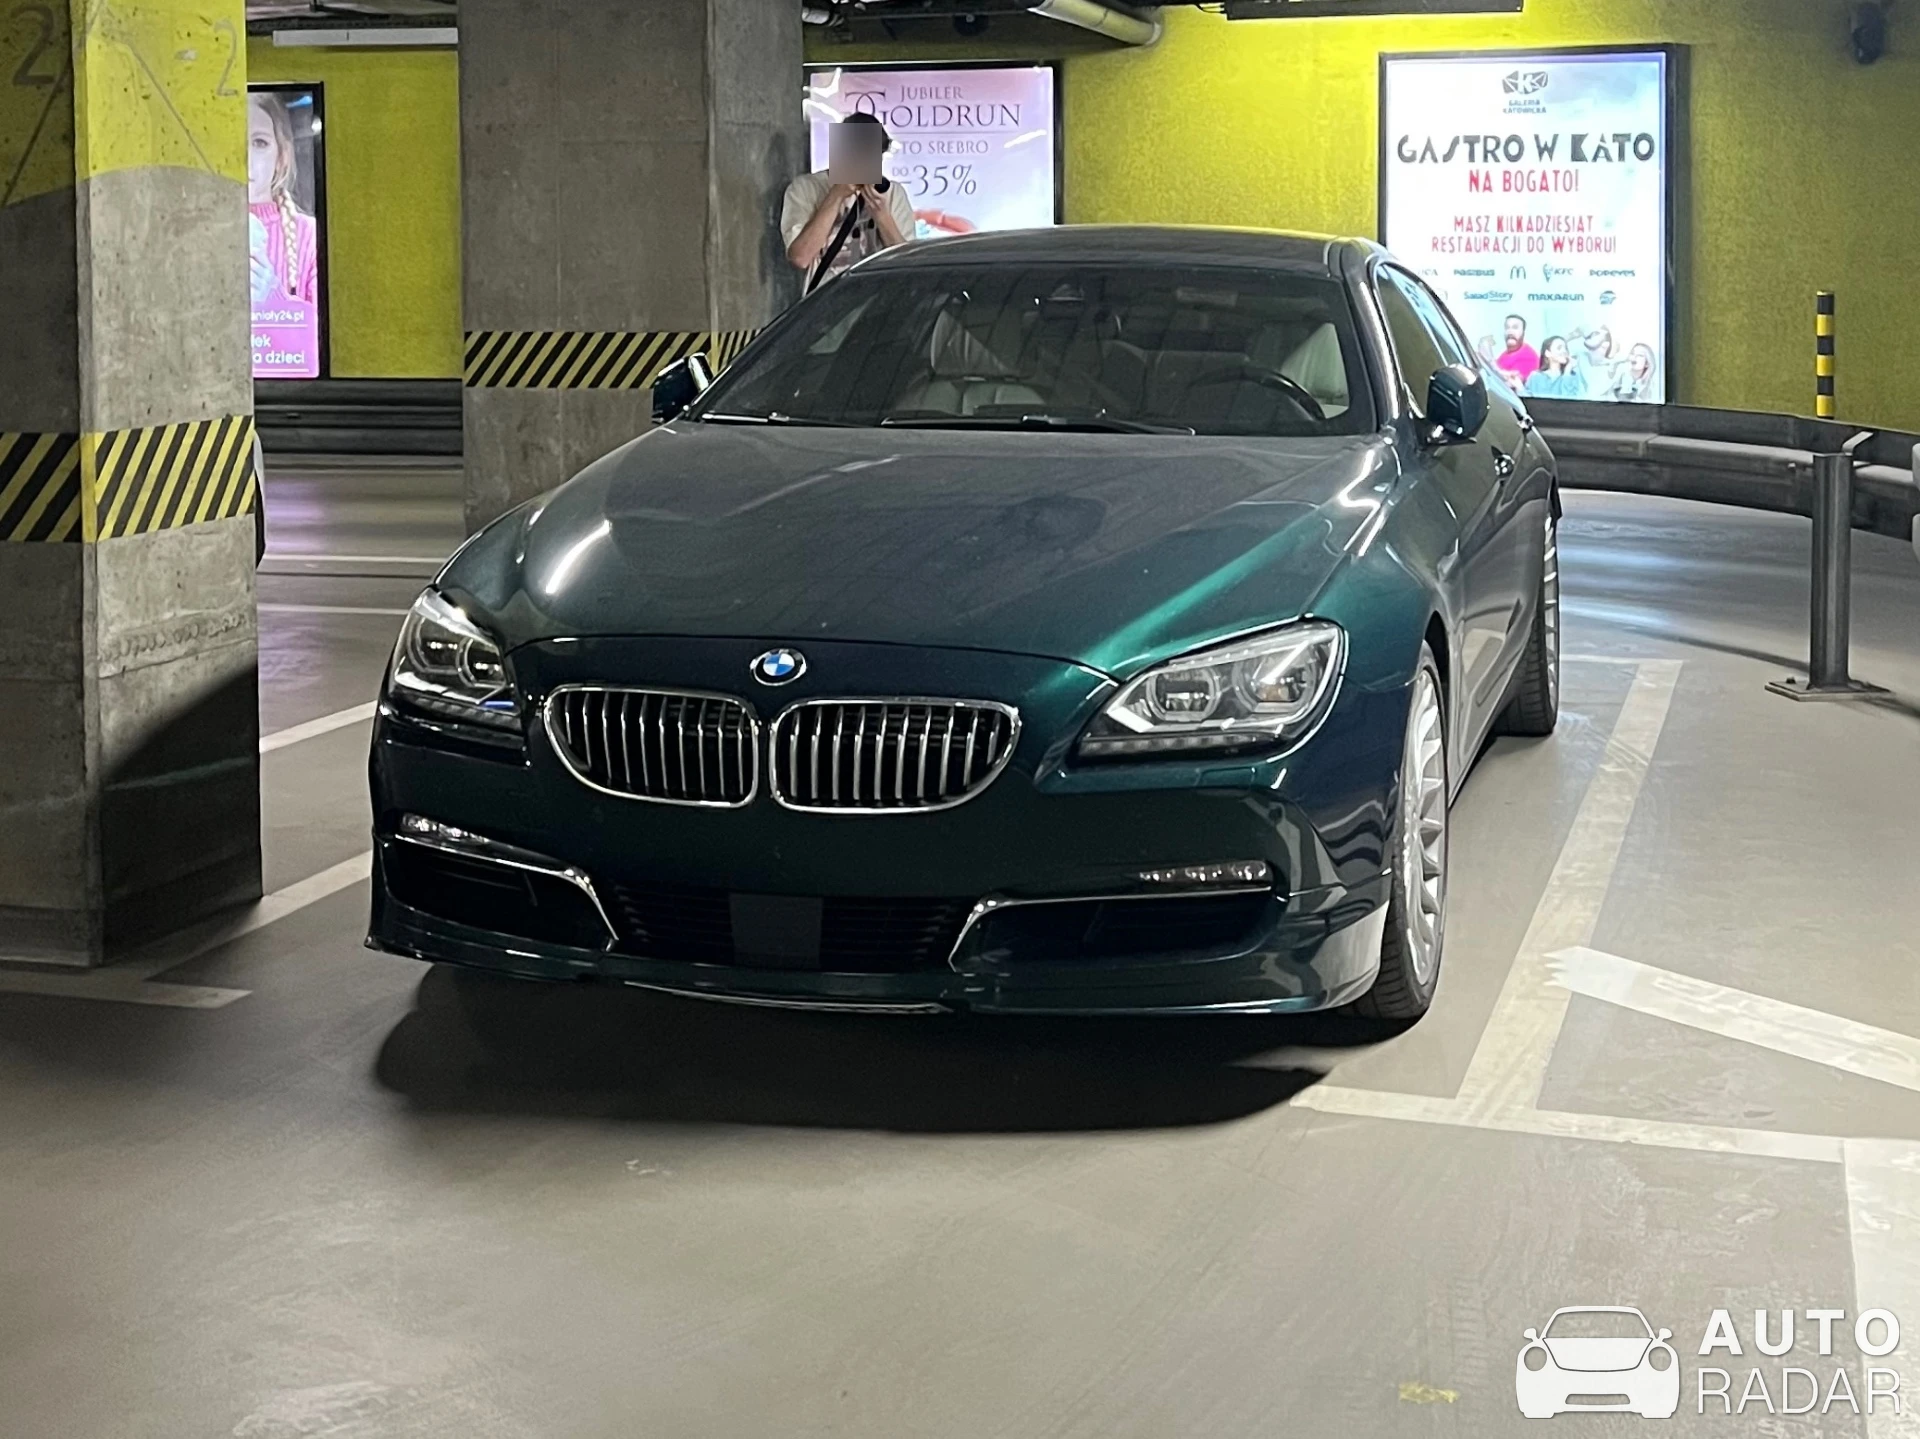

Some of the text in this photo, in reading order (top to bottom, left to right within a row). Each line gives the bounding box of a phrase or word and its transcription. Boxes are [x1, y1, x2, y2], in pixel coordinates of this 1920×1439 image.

[901, 86, 963, 103] JUBILER
[928, 139, 989, 154] SREBRO
[1397, 132, 1656, 164] GASTRO W KATO
[1468, 169, 1579, 193] NA BOGATO!
[1454, 215, 1490, 233] MASZ
[1431, 235, 1617, 254] RESTAURACJI DO WYBORU!
[265, 350, 305, 364] dzieci
